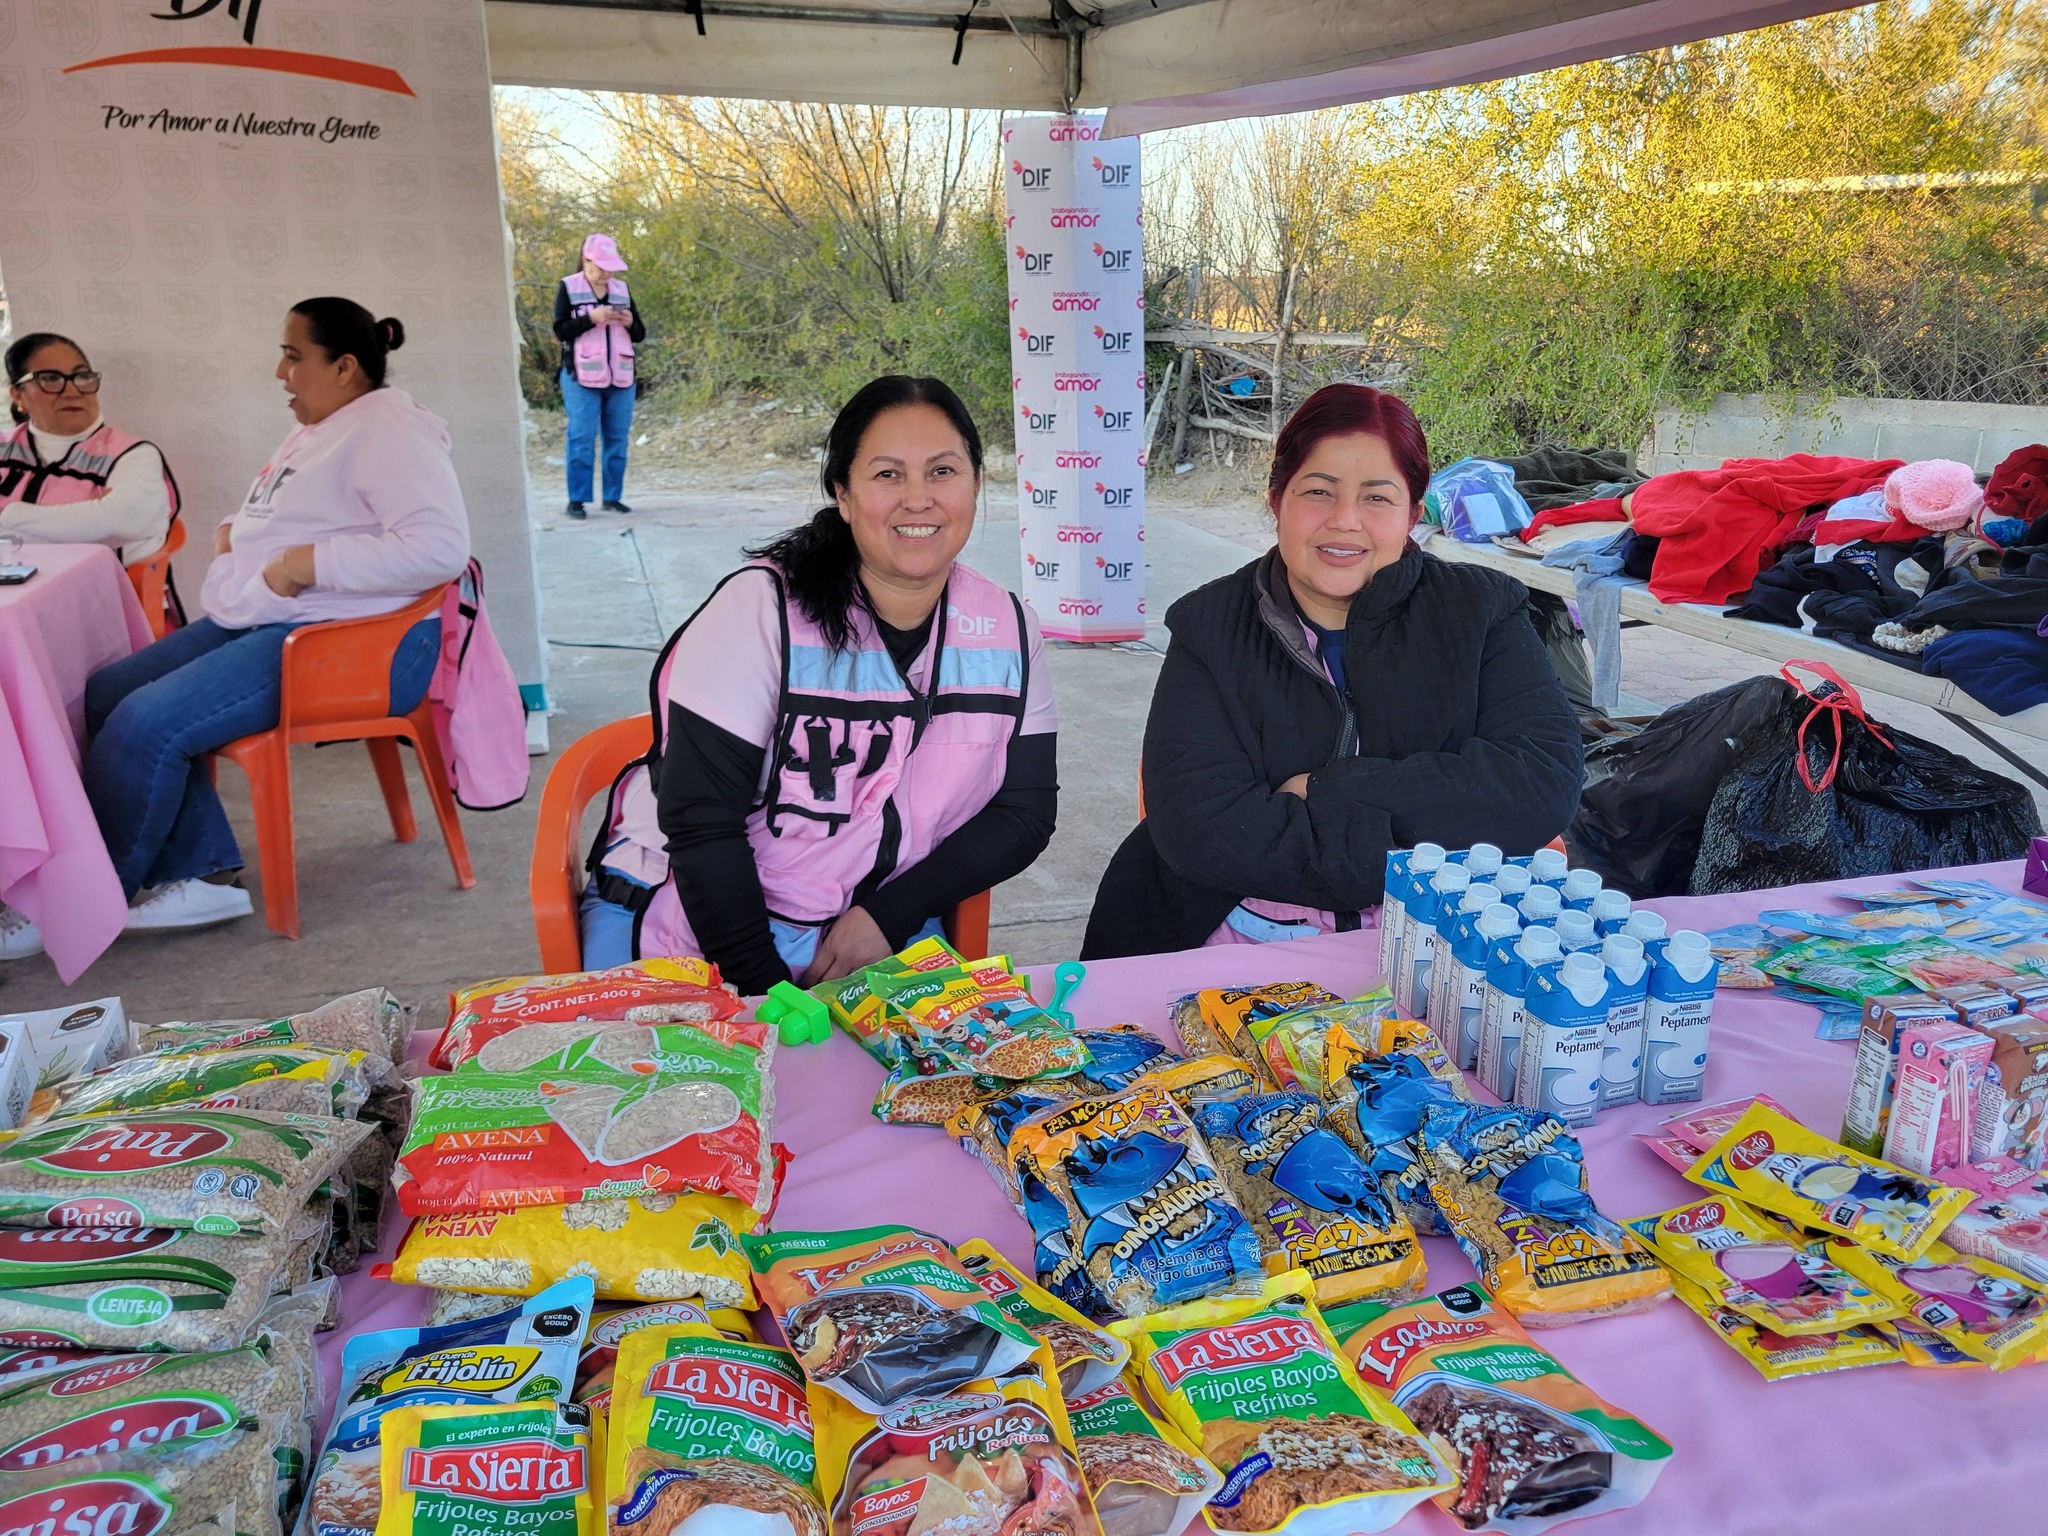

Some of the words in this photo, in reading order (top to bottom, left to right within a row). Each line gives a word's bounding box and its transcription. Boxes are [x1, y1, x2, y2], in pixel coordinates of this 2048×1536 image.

[101, 105, 145, 129] Por
[148, 109, 212, 134] Amor
[215, 117, 228, 131] a
[232, 113, 315, 138] Nuestra
[320, 116, 381, 143] Gente
[1050, 127, 1099, 142] amor
[1022, 168, 1052, 187] DIF
[1102, 165, 1132, 183] DIF
[1051, 215, 1100, 228] amor
[1025, 254, 1053, 271] DIF
[1102, 250, 1132, 268] DIF
[1052, 298, 1101, 311] amor
[1027, 335, 1055, 352] DIF
[1103, 332, 1132, 350] DIF
[1054, 379, 1101, 391] amor
[1030, 413, 1057, 430] DIF
[1103, 411, 1133, 428] DIF
[1056, 456, 1102, 469] amor
[1032, 489, 1058, 505] DIF
[1104, 488, 1133, 505] DIF
[1057, 531, 1102, 544] amor
[1035, 562, 1060, 578] DIF
[1104, 562, 1133, 578] DIF
[1058, 603, 1103, 616] amor
[958, 616, 997, 635] DIF
[889, 983, 943, 1004] Knorr
[949, 986, 980, 998] SOPA
[518, 1001, 564, 1017] CONT.
[565, 995, 599, 1008] NET.
[600, 989, 630, 1000] 400
[632, 990, 641, 999] g
[950, 995, 985, 1015] PASTA
[1660, 1015, 1711, 1031] Peptamen
[1609, 1086, 1632, 1095] UNFLAVORED
[1667, 1081, 1695, 1090] UNFLAVORED
[1562, 1108, 1589, 1116] UNFLAVORED
[438, 1129, 546, 1150] AVENA
[436, 1153, 473, 1167] 100%
[476, 1151, 534, 1162] Natural
[599, 1178, 645, 1196] Campo
[704, 1175, 721, 1191] 40
[417, 1197, 462, 1208] HOJUELA
[465, 1197, 479, 1206] DE
[485, 1189, 557, 1208] AVENA
[61, 1203, 134, 1228] Paisa
[1113, 1179, 1224, 1259] DINOSAURIOS
[425, 1218, 500, 1239] AVENA
[780, 1237, 827, 1249] México
[798, 1238, 941, 1295] Isadora
[865, 1263, 930, 1286] Frijoles
[931, 1265, 977, 1286] Refrit
[1108, 1266, 1140, 1293] Pasta
[1140, 1257, 1156, 1272] de
[1157, 1249, 1207, 1269] sémola
[1208, 1246, 1223, 1260] de
[1183, 1259, 1228, 1279] durum
[912, 1273, 970, 1292] Negros
[1446, 1291, 1470, 1301] EXCESO
[1452, 1298, 1473, 1306] SODIO
[99, 1297, 163, 1316] LENTEJA
[543, 1314, 573, 1322] EXCESO
[608, 1304, 694, 1330] PUEBLO
[440, 1350, 476, 1360] Duende
[1167, 1341, 1217, 1375] La
[1217, 1321, 1315, 1362] Sierra
[1359, 1314, 1484, 1384] Isadora
[707, 1346, 749, 1357] experto
[752, 1352, 765, 1361] en
[767, 1354, 801, 1379] Frijoles
[1438, 1351, 1497, 1372] Frijoles
[1498, 1350, 1558, 1368] Refrito
[62, 1356, 155, 1393] Paisa
[404, 1357, 517, 1384] Frijolín
[1486, 1364, 1546, 1382] Negros
[530, 1381, 550, 1394] Sin
[1186, 1374, 1268, 1406] Frijoles
[1274, 1361, 1340, 1389] Bayos
[663, 1362, 708, 1394] La
[714, 1364, 814, 1429] Sierra
[1233, 1391, 1319, 1417] Refritos
[910, 1400, 974, 1415] RICO
[1081, 1400, 1138, 1422] Bayos
[446, 1433, 455, 1442] El
[458, 1425, 500, 1440] experto
[502, 1425, 515, 1434] en
[518, 1421, 552, 1437] Frijoles
[928, 1415, 1033, 1461] Frijoles
[650, 1408, 744, 1441] Frijoles
[744, 1426, 817, 1474] Bayos
[986, 1432, 1050, 1454] Refritos
[421, 1455, 461, 1486] La
[467, 1451, 573, 1493] Sierra
[646, 1474, 656, 1486] Sin
[1401, 1464, 1424, 1478] 430
[1179, 1476, 1197, 1486] 220
[1217, 1456, 1269, 1505] CONSERVADORES
[864, 1489, 911, 1514] Bayos
[413, 1500, 498, 1525] Frijoles
[504, 1506, 575, 1526] Bayos
[860, 1505, 918, 1533] CONSERVADORES
[451, 1523, 540, 1536] Refritos
